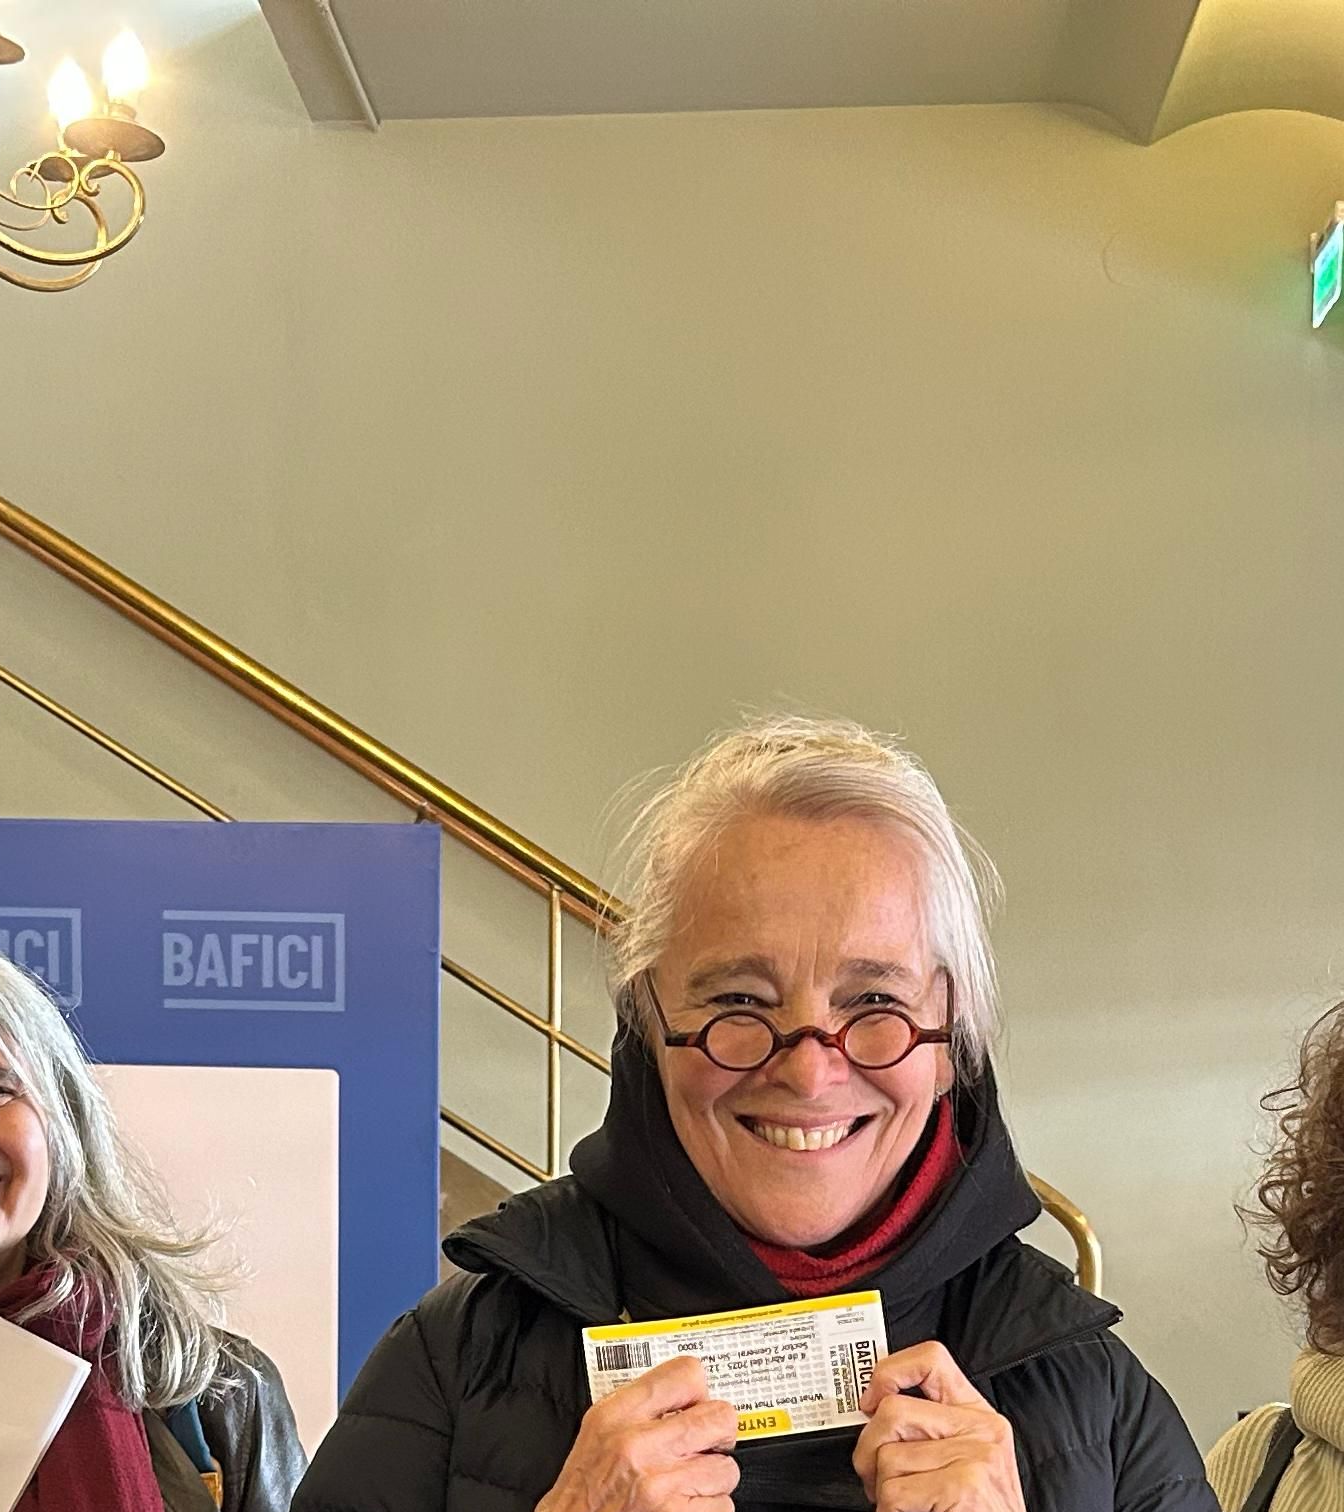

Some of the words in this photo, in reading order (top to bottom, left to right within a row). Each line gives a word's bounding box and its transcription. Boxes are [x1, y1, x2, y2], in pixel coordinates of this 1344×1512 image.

[163, 931, 324, 991] BAFICI
[773, 1345, 778, 1353] 2
[781, 1341, 808, 1352] Sector
[737, 1347, 771, 1358] General
[855, 1340, 873, 1394] BAFICI
[775, 1396, 797, 1406] Does
[798, 1392, 823, 1403] What
[754, 1399, 773, 1409] That
[736, 1416, 776, 1431] ENTR
